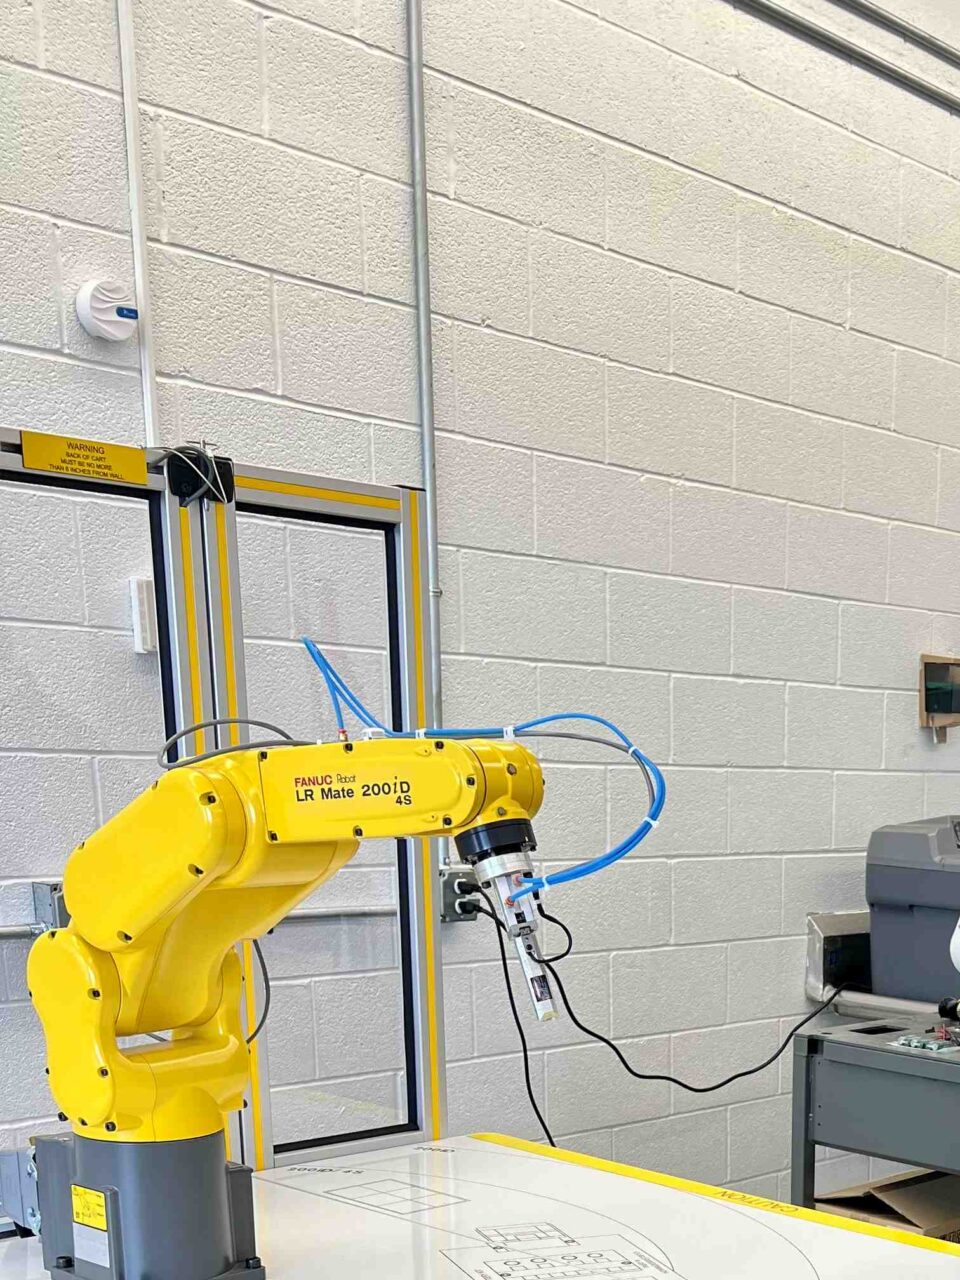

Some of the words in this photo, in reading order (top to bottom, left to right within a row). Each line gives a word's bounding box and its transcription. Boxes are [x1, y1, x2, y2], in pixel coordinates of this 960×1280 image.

[66, 441, 105, 455] WARNING
[65, 451, 81, 460] BACK
[91, 455, 106, 463] CART
[49, 463, 66, 472] THAN
[71, 466, 91, 475] INCHES
[92, 469, 109, 478] FROM
[60, 458, 77, 466] MUST
[86, 461, 95, 469] NO
[96, 463, 113, 471] MORE
[294, 774, 333, 788] FANUC
[336, 773, 356, 784] Robot
[296, 789, 315, 802] LR
[321, 786, 355, 800] Mate
[361, 776, 411, 797] 200iD
[395, 795, 412, 806] 4S
[713, 1190, 799, 1213] CAUTION
